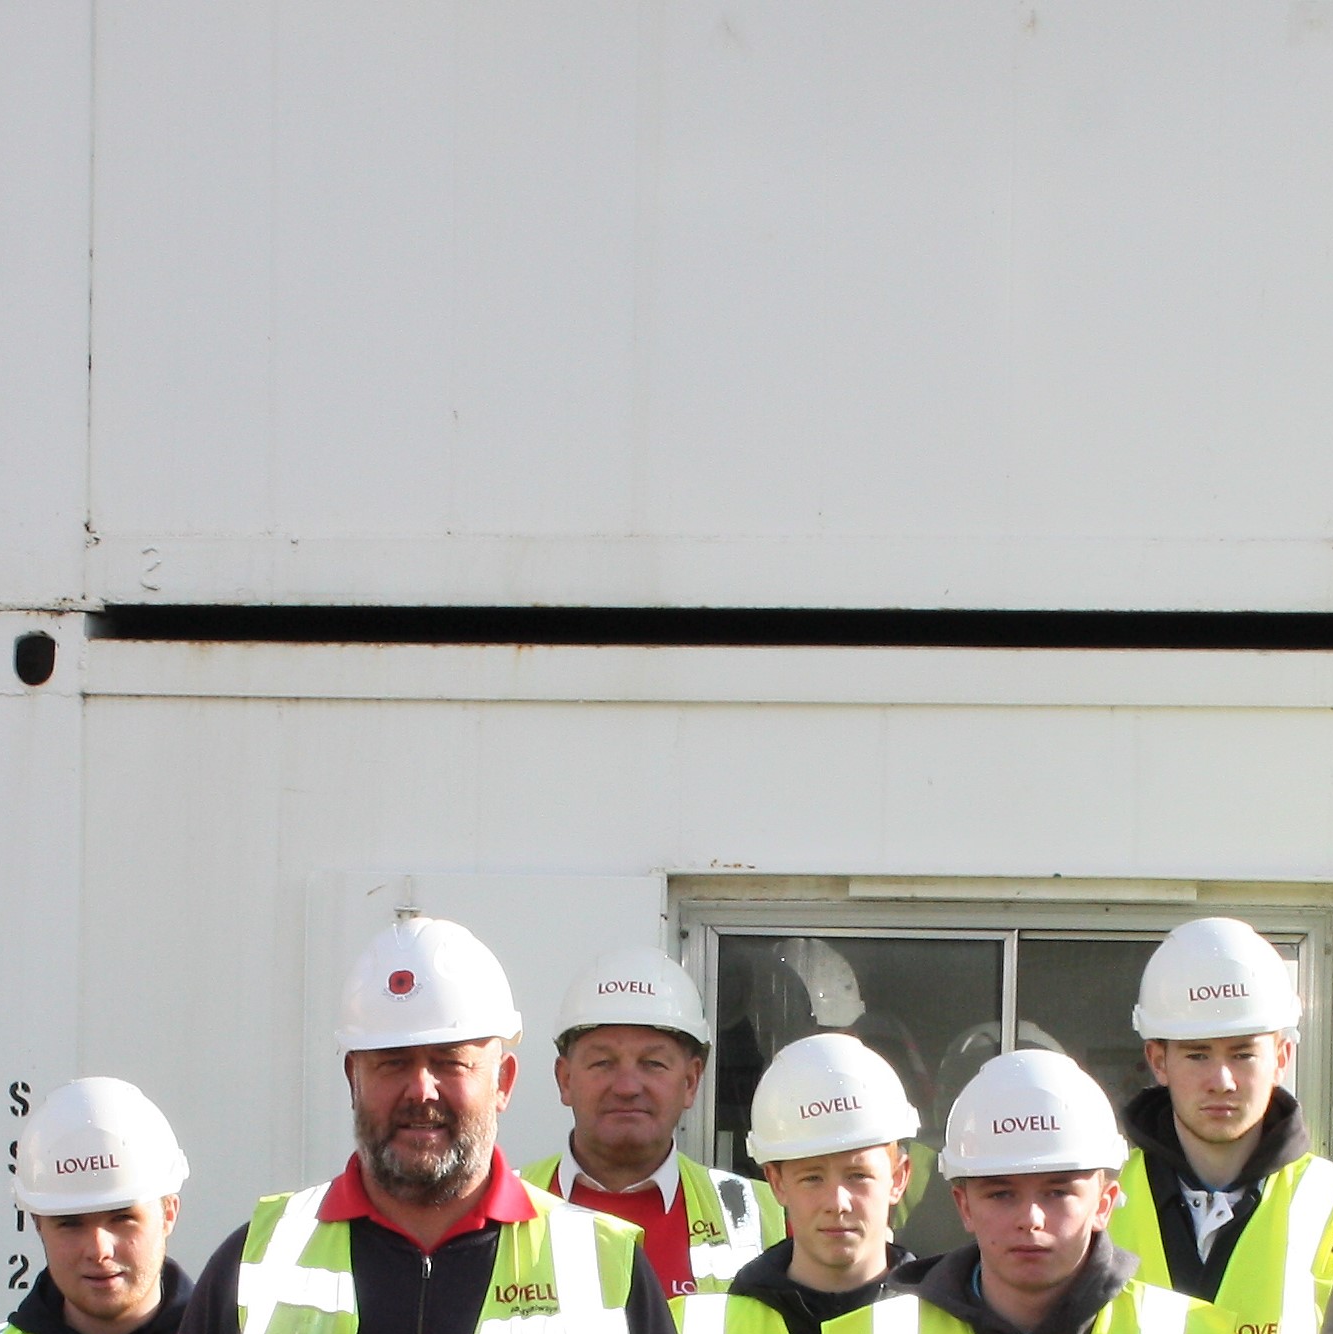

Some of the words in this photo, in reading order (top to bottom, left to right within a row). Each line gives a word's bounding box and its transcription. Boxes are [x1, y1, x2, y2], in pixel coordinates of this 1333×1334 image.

[597, 981, 657, 996] LOVELL
[1188, 983, 1250, 1002] LOVELL
[799, 1097, 862, 1121] LOVELL
[992, 1116, 1061, 1135] LOVELL
[55, 1154, 119, 1175] LOVELL
